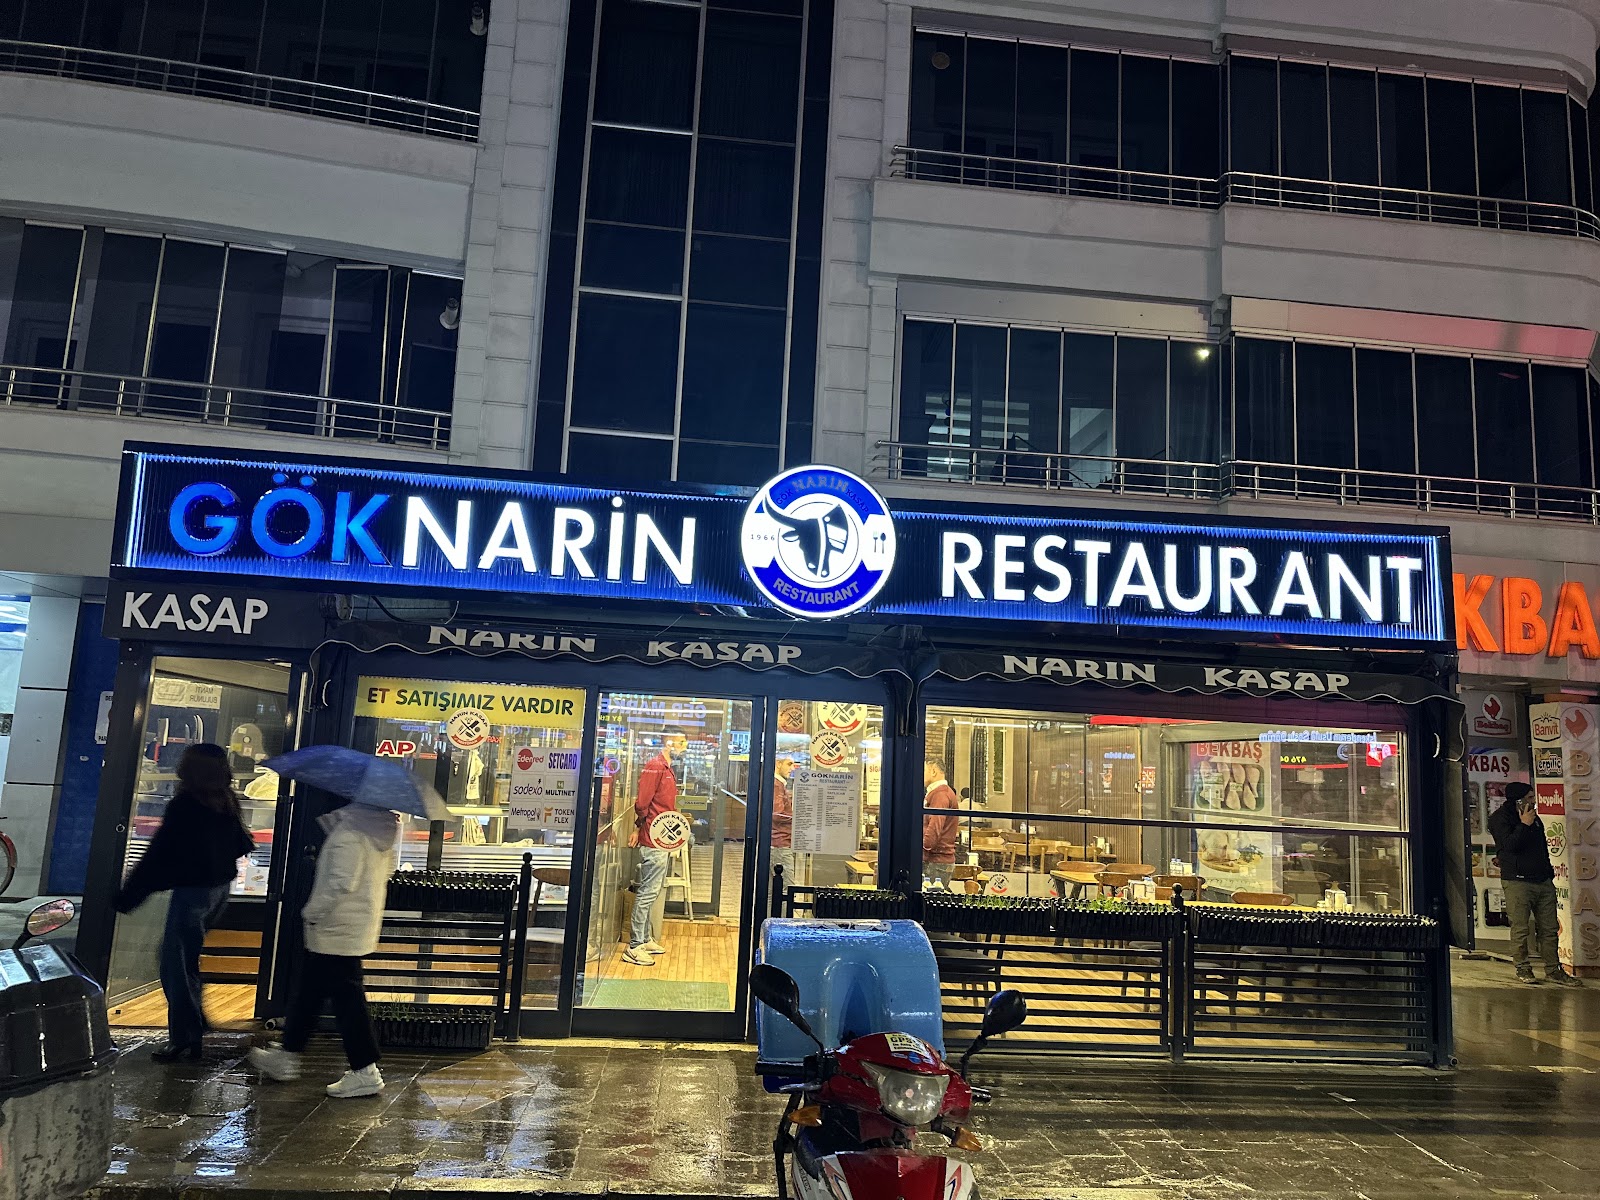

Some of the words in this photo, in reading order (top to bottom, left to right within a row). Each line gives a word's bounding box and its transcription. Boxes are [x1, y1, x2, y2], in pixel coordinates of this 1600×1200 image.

[941, 530, 1423, 624] RESTAURANT
[772, 577, 861, 605] RESTAURANT
[122, 592, 270, 635] KASAP
[427, 625, 597, 653] NARIN
[646, 638, 803, 665] KASAP
[1002, 654, 1157, 683] NARIN
[1203, 667, 1351, 694] KASAP
[367, 687, 390, 704] ET
[394, 688, 496, 711] SATIŞIMIZ
[500, 695, 575, 716] VARDIR
[1534, 722, 1559, 737] Banvit
[517, 754, 545, 764] Edenred
[548, 752, 578, 770] SETCARD
[1196, 741, 1263, 764] BEKBAŞ
[513, 782, 543, 796] sodexo
[510, 807, 537, 818] Metropol
[554, 808, 575, 816] TOKEN
[554, 816, 569, 824] FLEX
